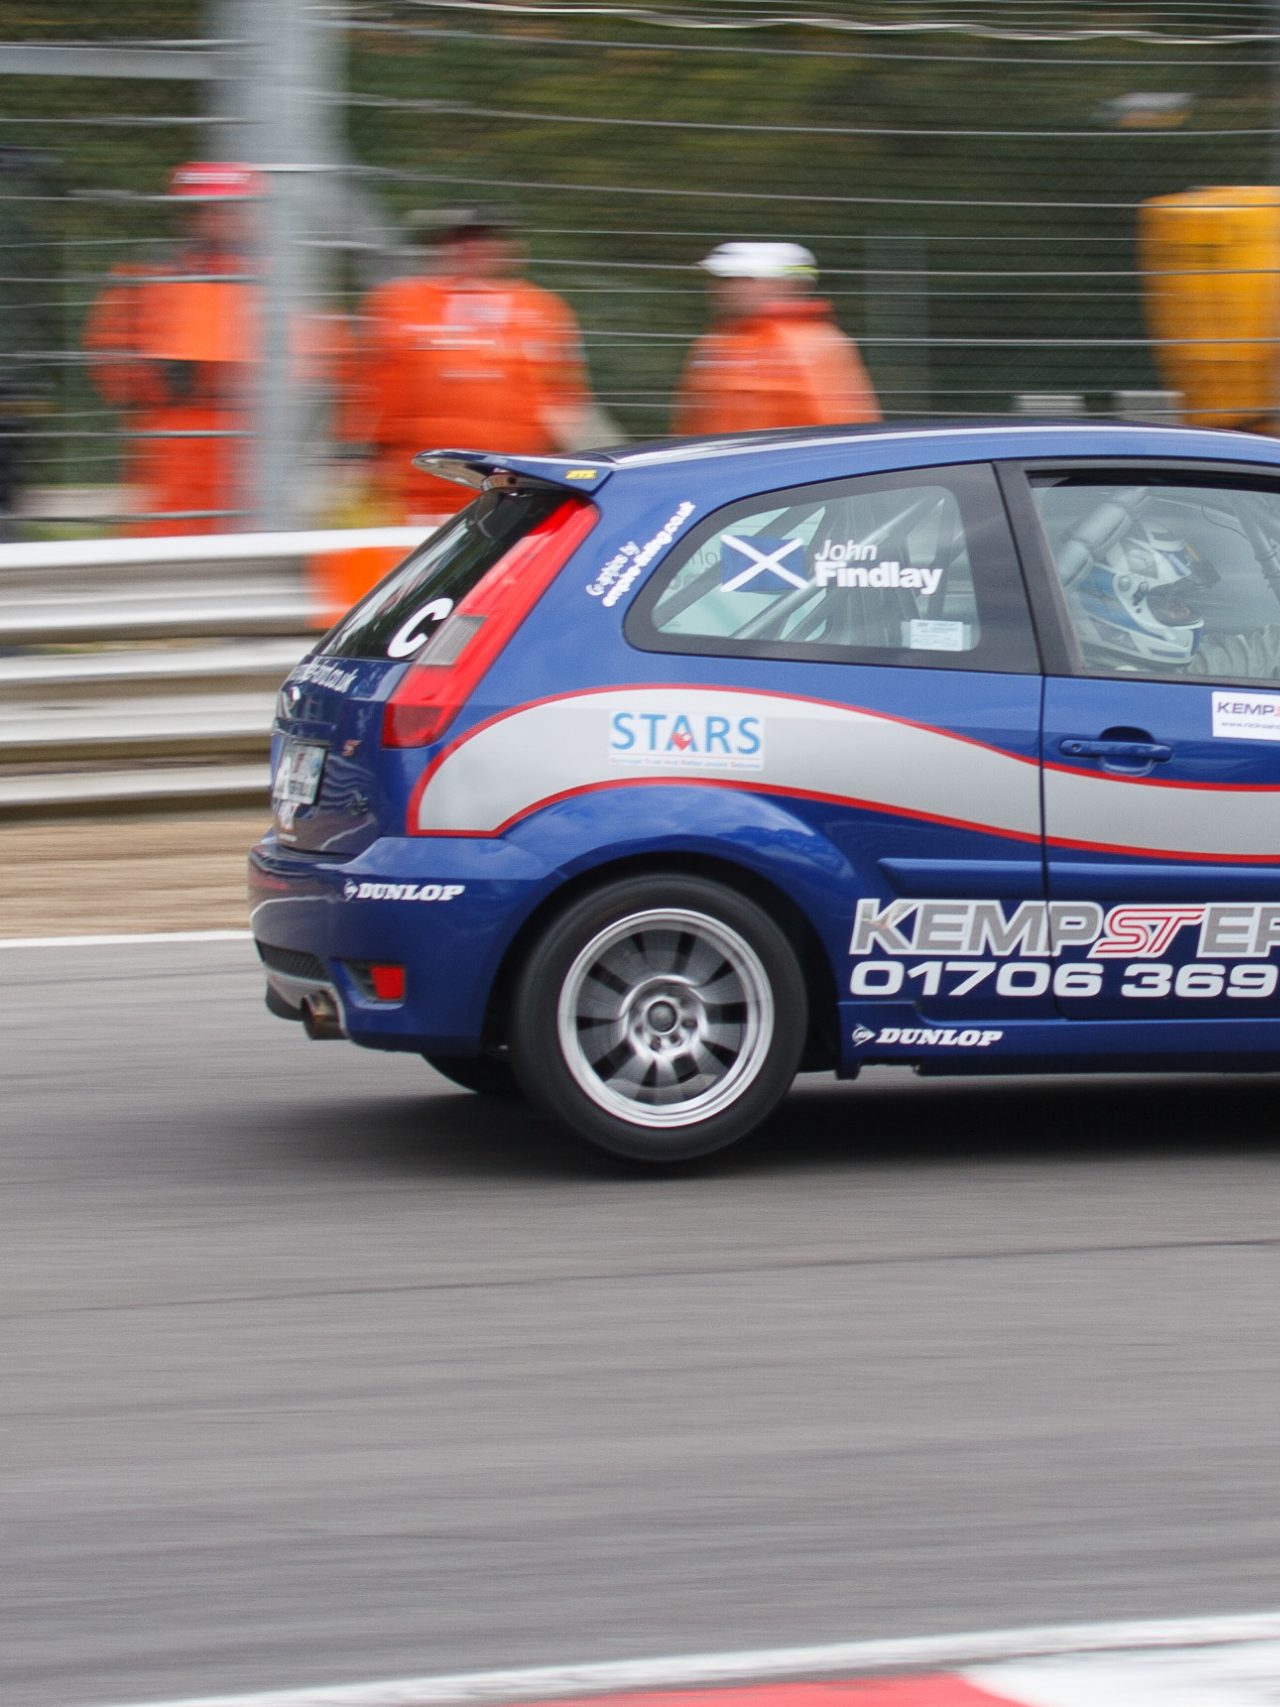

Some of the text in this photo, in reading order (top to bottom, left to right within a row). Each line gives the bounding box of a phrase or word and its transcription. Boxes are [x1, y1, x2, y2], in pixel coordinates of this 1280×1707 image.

[814, 540, 878, 562] John
[815, 562, 943, 595] Findlay
[387, 598, 454, 658] C
[611, 712, 761, 755] STARS
[356, 882, 466, 901] DUNLOP
[850, 961, 1104, 998] 01706
[1120, 963, 1280, 999] 369
[875, 1028, 1004, 1046] DUNLOP
